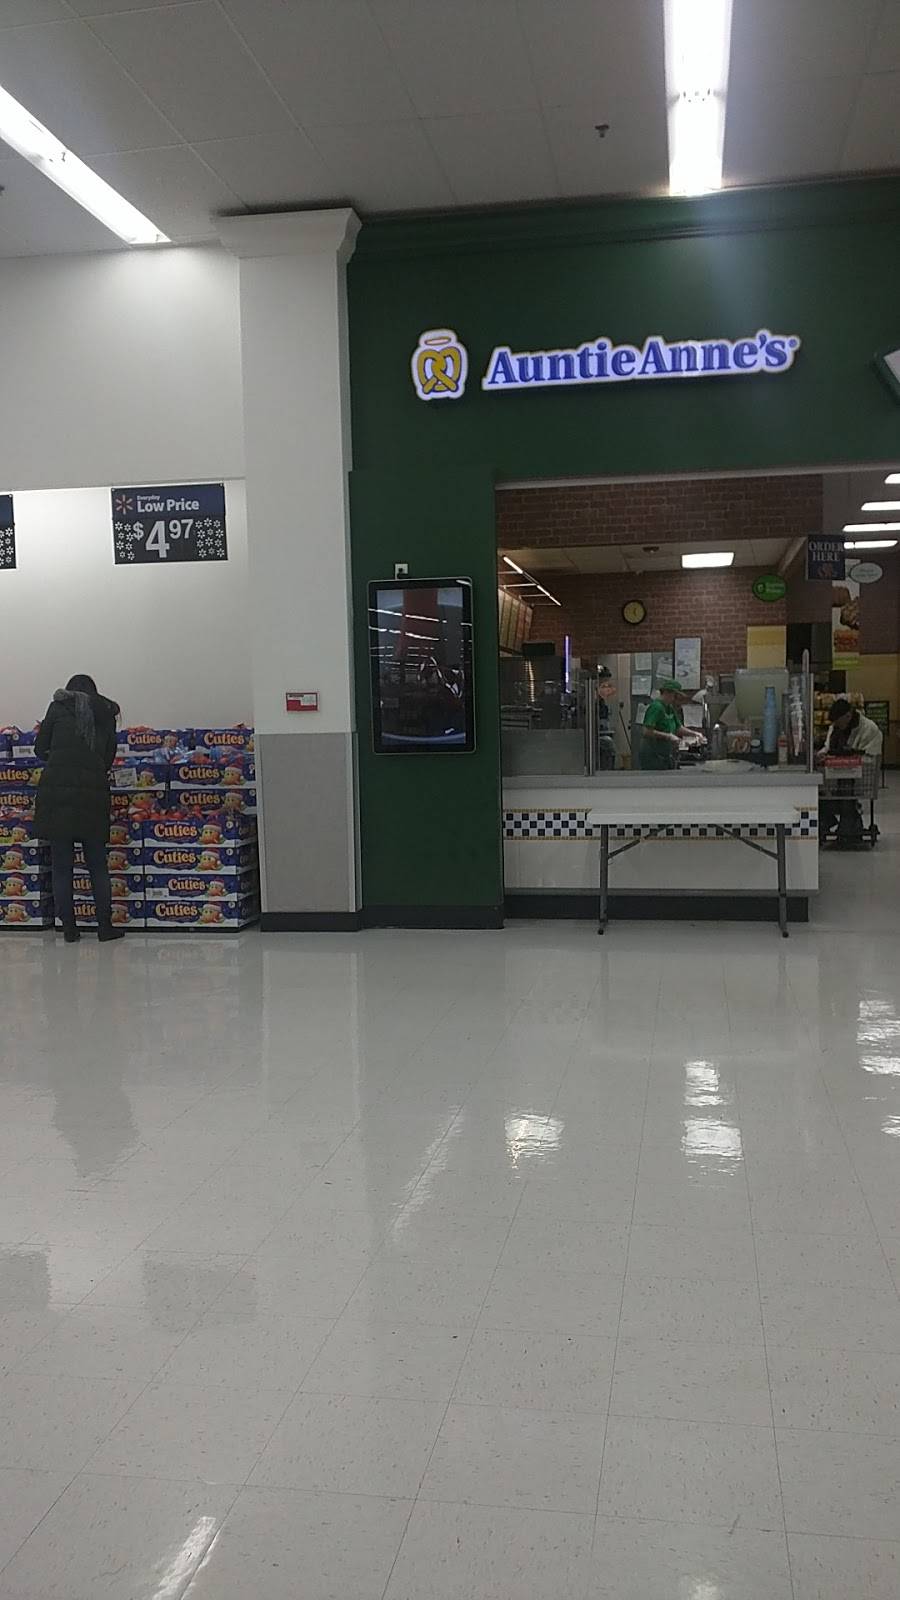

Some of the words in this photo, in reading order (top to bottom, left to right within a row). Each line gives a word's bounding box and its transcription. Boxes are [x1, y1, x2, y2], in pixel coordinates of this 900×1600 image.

[137, 500, 164, 513] Low
[166, 498, 199, 511] Price
[809, 541, 844, 552] ORDER
[812, 551, 840, 562] HERE
[127, 733, 162, 745] Cuties
[204, 732, 245, 745] Cuties
[0, 769, 29, 781] uties
[179, 766, 220, 780] Cuties
[179, 792, 221, 806] Cuties
[154, 823, 198, 838] Cuties
[153, 850, 197, 864] Cuties
[168, 879, 206, 891] Cuties
[155, 904, 198, 917] Cuties
